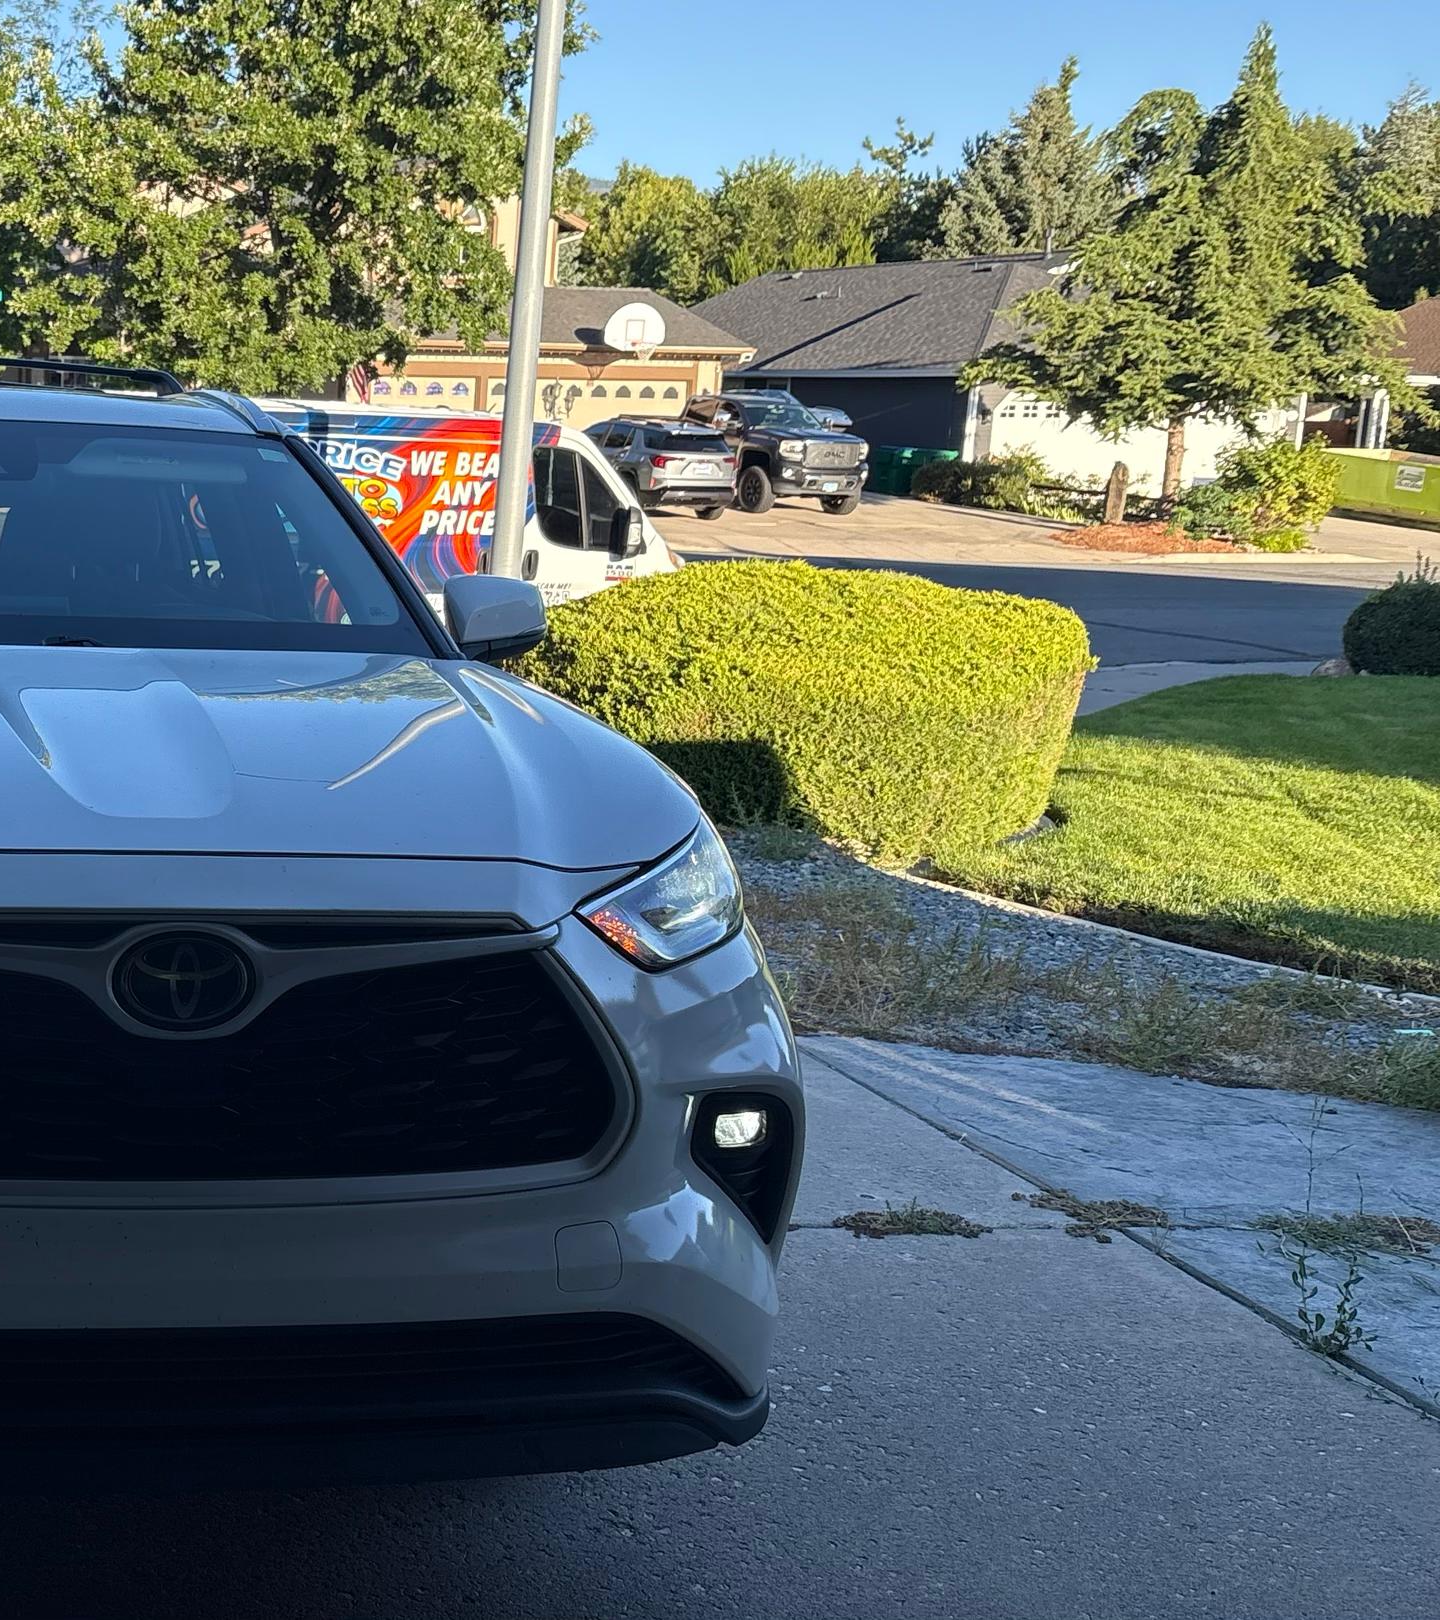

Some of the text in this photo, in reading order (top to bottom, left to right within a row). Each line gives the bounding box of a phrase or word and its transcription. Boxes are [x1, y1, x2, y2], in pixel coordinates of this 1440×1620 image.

[410, 450, 501, 478] WE BEA
[340, 477, 388, 499] TO
[431, 480, 493, 506] ANY
[419, 509, 496, 536] PRICE
